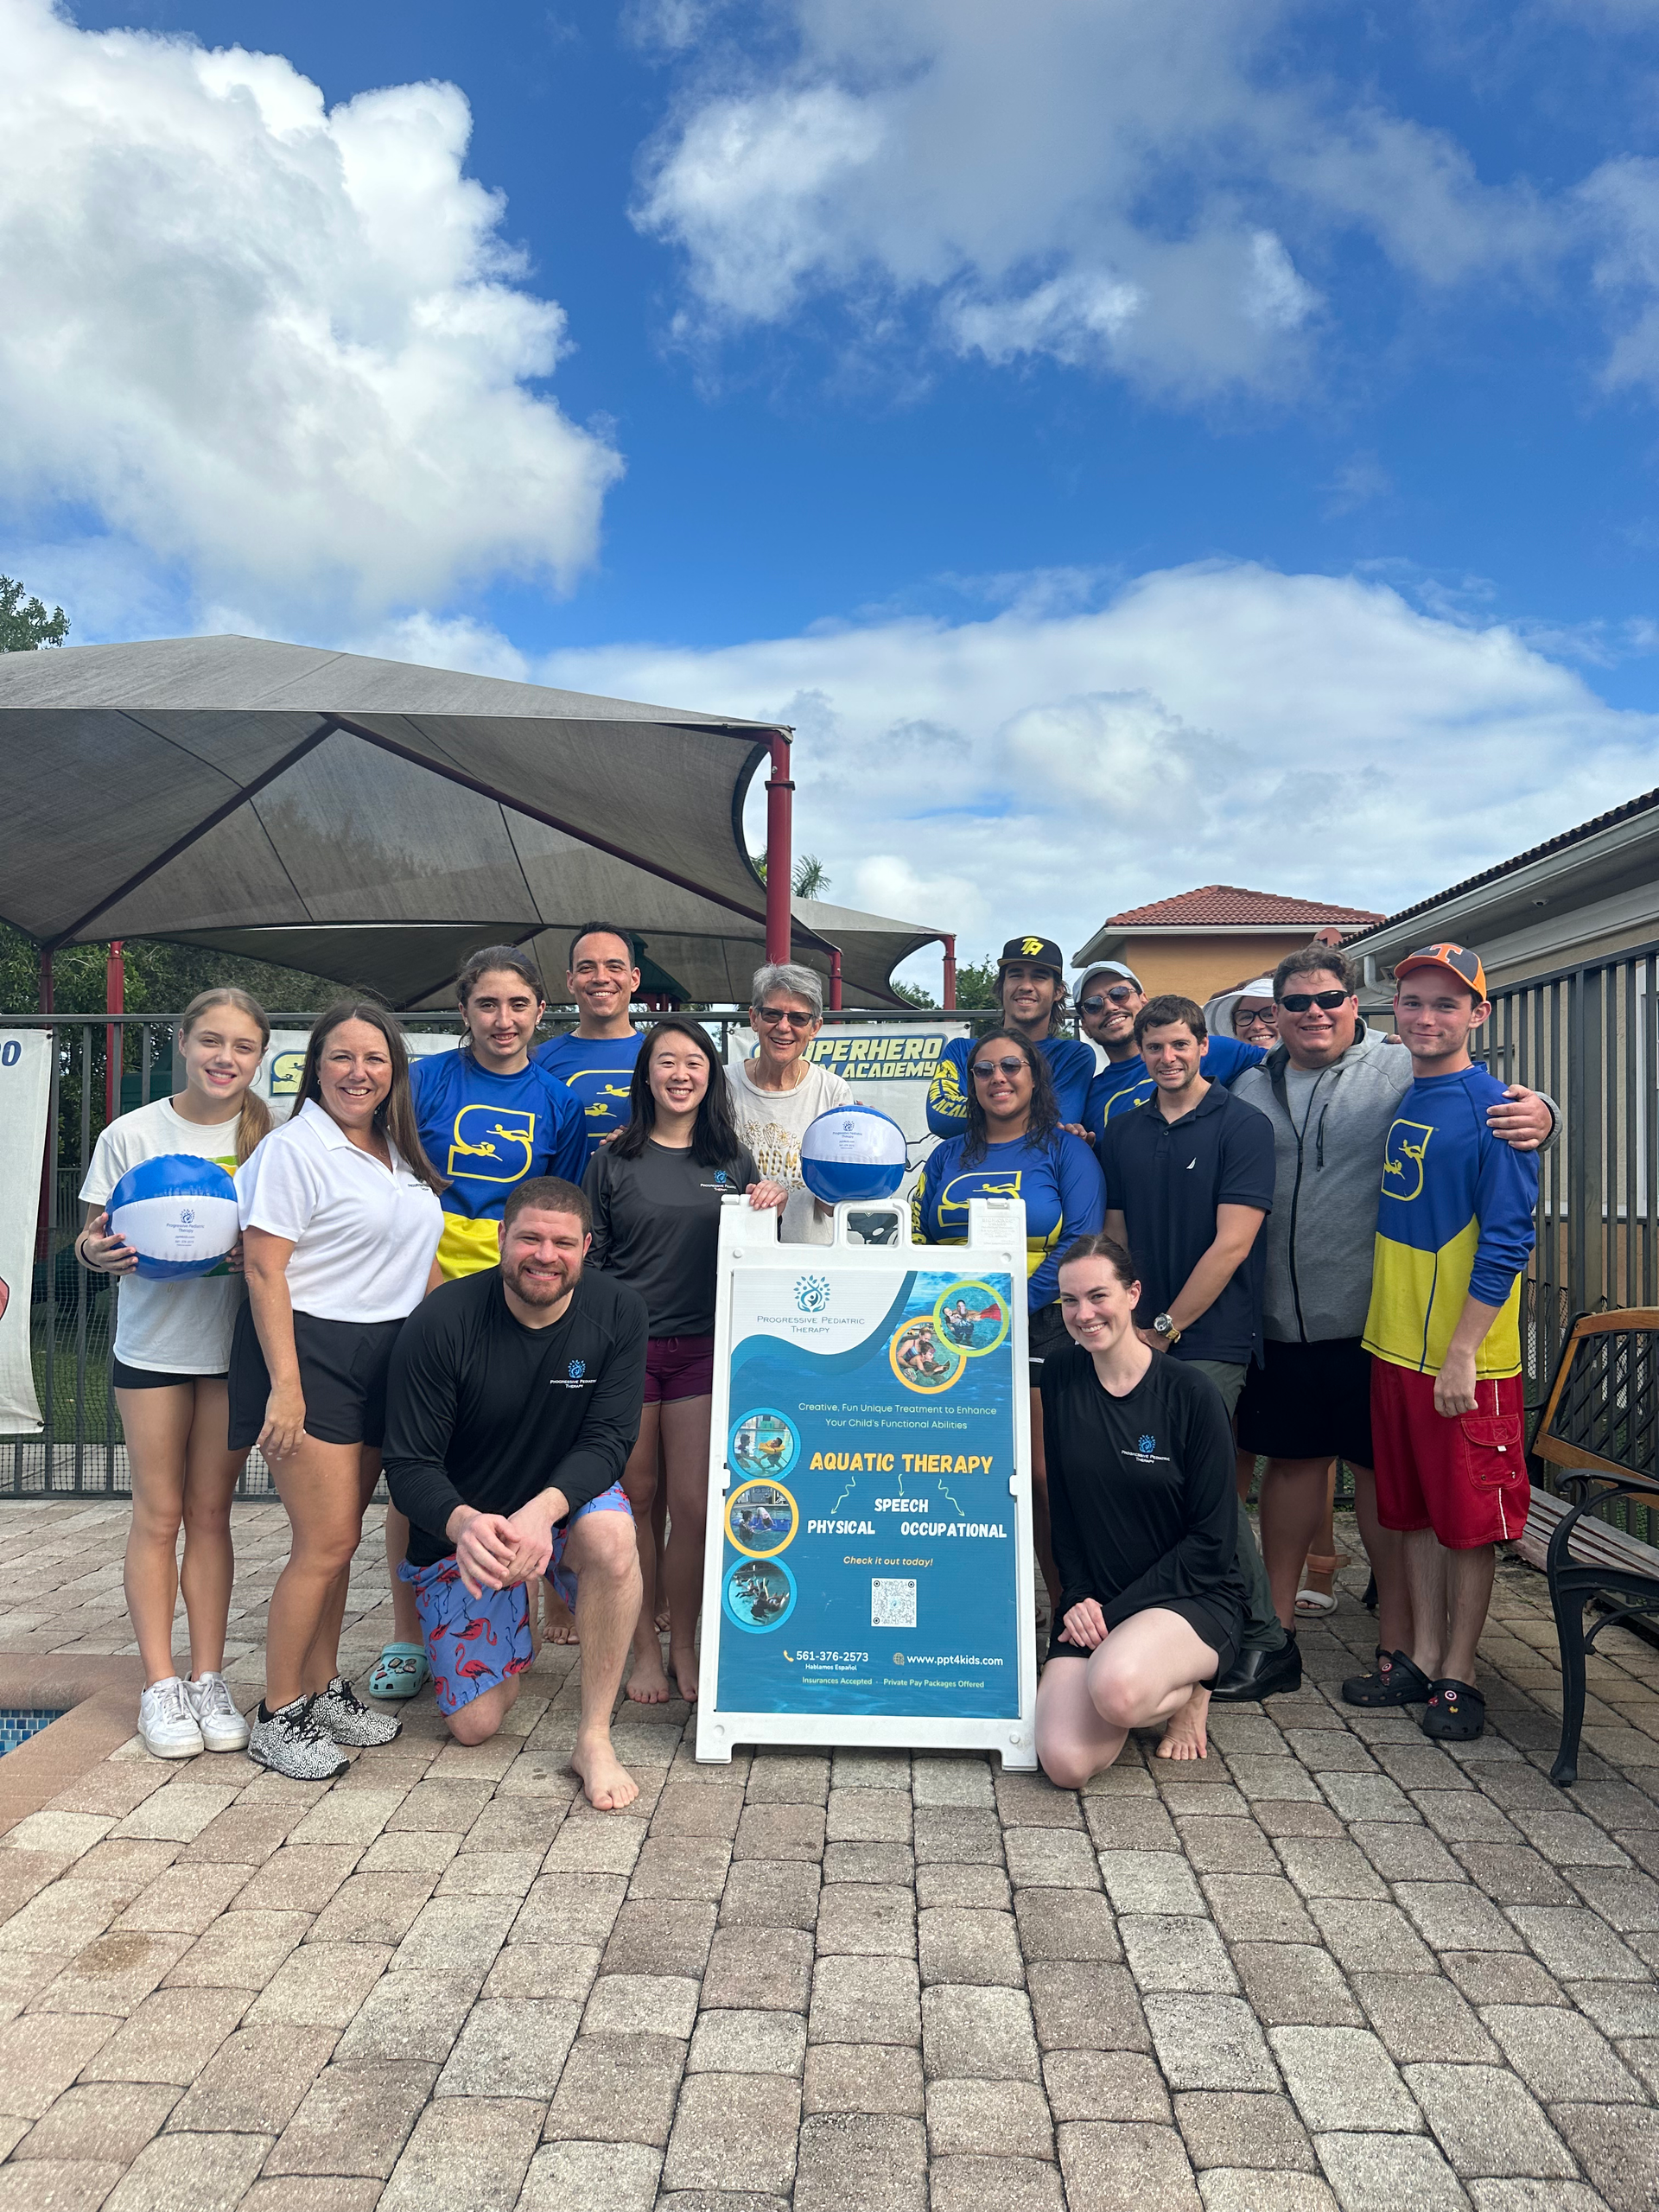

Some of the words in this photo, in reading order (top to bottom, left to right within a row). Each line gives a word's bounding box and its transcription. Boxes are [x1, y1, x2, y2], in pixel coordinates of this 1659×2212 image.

[1430, 944, 1463, 963] T
[842, 1061, 938, 1078] ACADEMY
[798, 1402, 840, 1412] Creative,
[842, 1403, 859, 1412] Fun
[861, 1404, 893, 1414] Unique
[894, 1404, 943, 1414] Treatment
[944, 1406, 955, 1414] to
[957, 1406, 997, 1414] Enhance
[825, 1418, 847, 1427] Your
[849, 1418, 879, 1427] Child's
[880, 1419, 929, 1428] Functional
[931, 1420, 968, 1429] Abilities
[810, 1452, 894, 1471] AQUATIC
[902, 1453, 993, 1474] THERAPY
[874, 1497, 929, 1513] SPEECH
[807, 1519, 876, 1535] PHYSICAL
[900, 1521, 1007, 1538] OCCUPATIONAL
[843, 1555, 873, 1565] Check
[874, 1556, 882, 1565] it
[884, 1557, 900, 1566] out
[902, 1557, 933, 1568] today!
[796, 1650, 869, 1662] 561-376-2573
[906, 1654, 1004, 1667] www.ppt4kids.com
[835, 1663, 857, 1672] Español
[840, 1676, 873, 1686] Accepted
[909, 1678, 922, 1688] Pay
[924, 1679, 957, 1688] Packages
[958, 1680, 985, 1688] Offered
